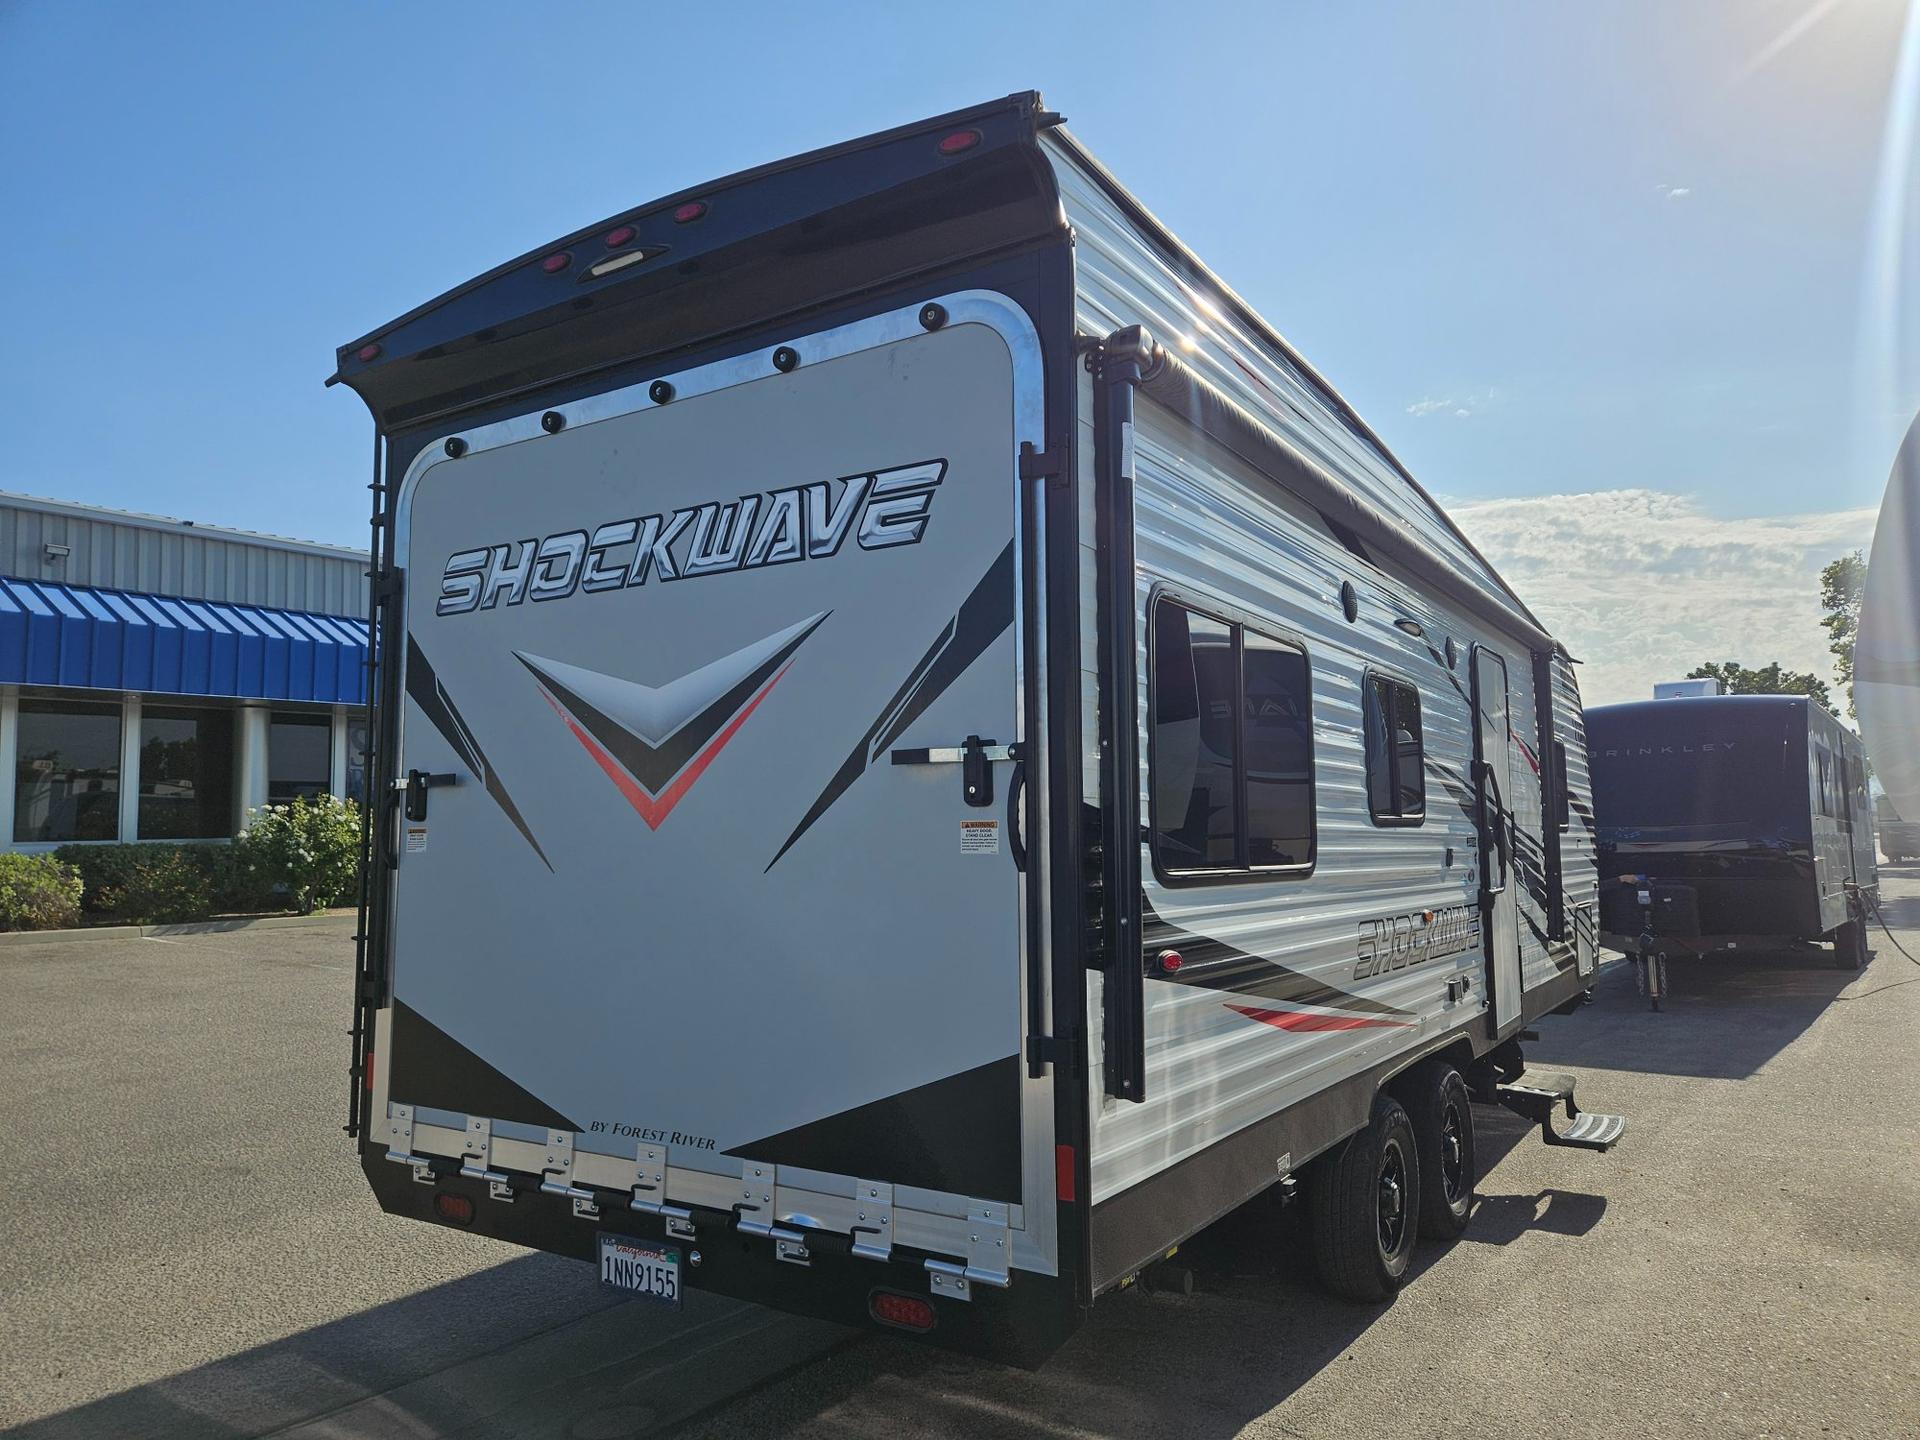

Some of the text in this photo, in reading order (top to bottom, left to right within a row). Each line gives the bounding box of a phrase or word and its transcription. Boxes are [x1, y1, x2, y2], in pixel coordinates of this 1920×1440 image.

[436, 458, 949, 616] SHOCKWAVE
[590, 1121, 716, 1151] BY FOREST RIVER
[604, 1255, 676, 1299] 1NN9155
